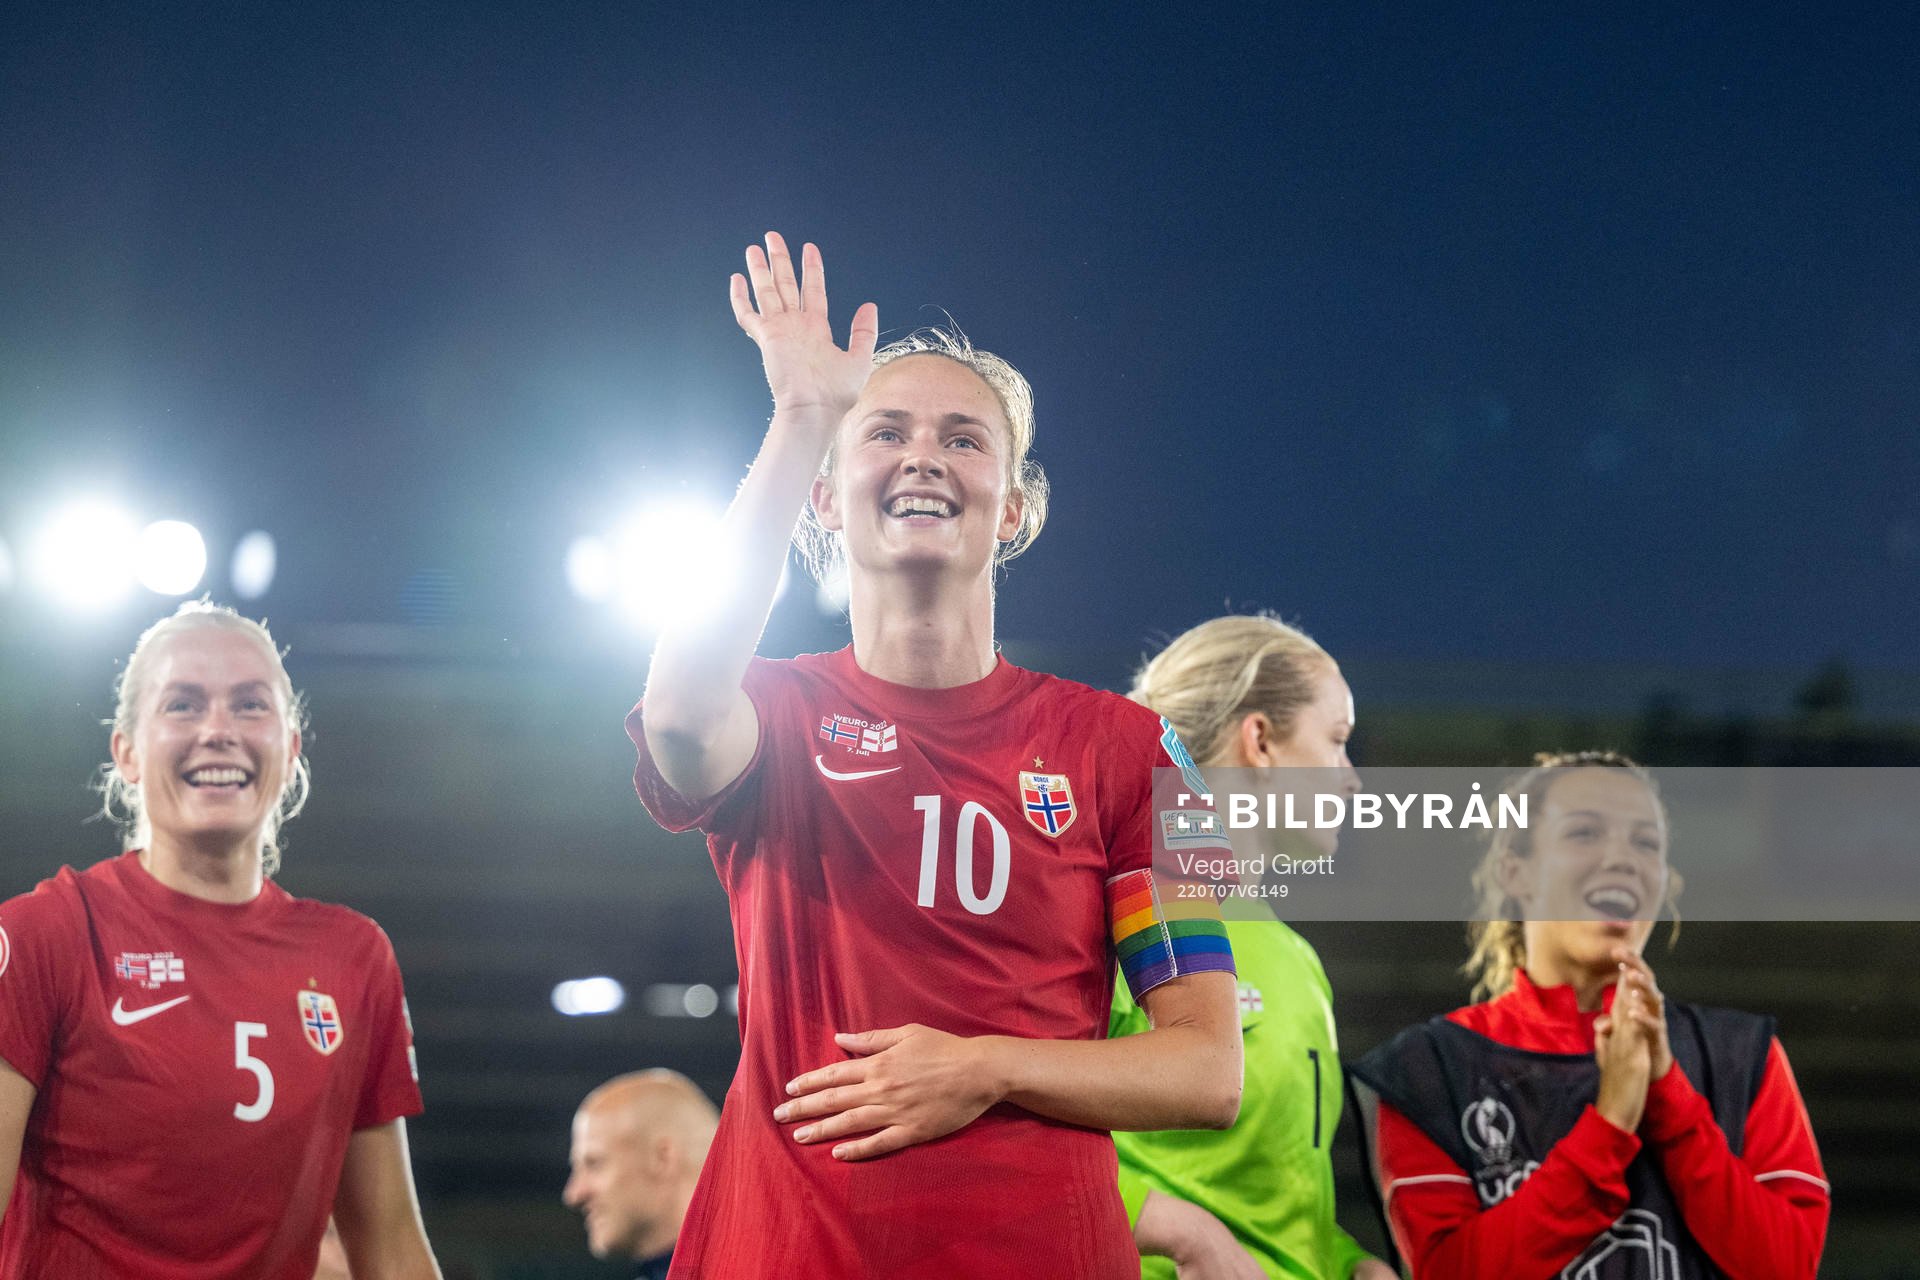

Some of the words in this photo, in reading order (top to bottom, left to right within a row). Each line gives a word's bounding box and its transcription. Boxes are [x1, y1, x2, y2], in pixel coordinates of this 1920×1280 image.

[833, 713, 868, 728] WEURO
[914, 795, 1011, 915] 10
[234, 1021, 275, 1122] 5
[1308, 1050, 1321, 1148] 1
